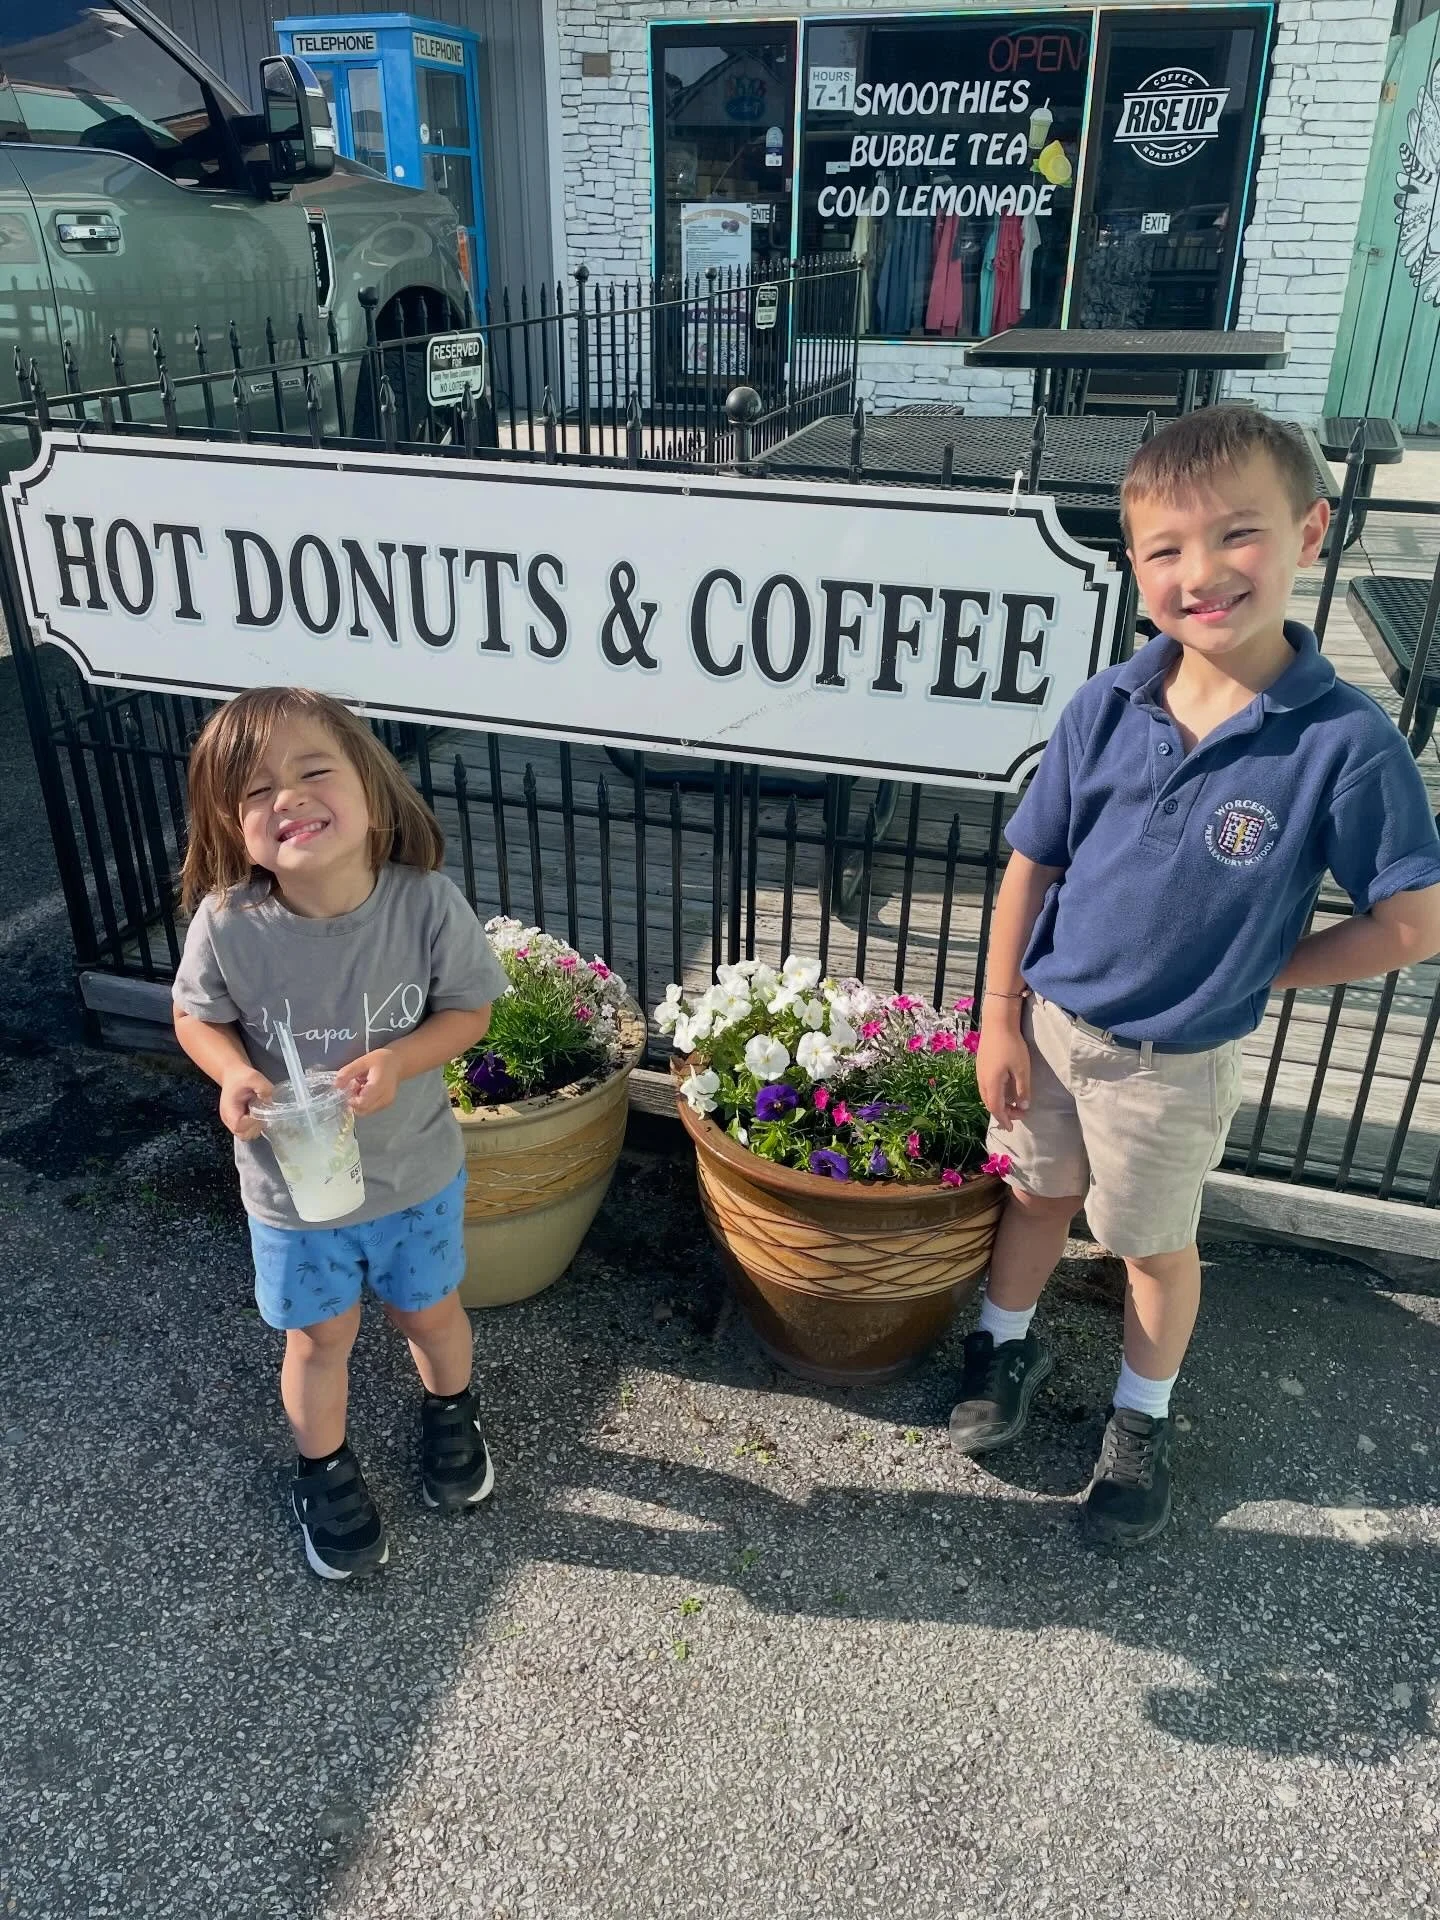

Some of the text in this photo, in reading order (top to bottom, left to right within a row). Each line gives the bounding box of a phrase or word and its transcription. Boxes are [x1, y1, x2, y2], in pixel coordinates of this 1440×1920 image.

[296, 34, 374, 52] TELEPHONE
[414, 37, 463, 63] TELEPHONE
[988, 34, 1083, 72] OPEN
[812, 71, 854, 82] HOURS:
[1153, 73, 1195, 86] COFFEE
[814, 84, 847, 107] 7-1
[853, 79, 1031, 115] SMOOTHIES
[1125, 97, 1219, 133] RISE UP
[850, 132, 1028, 167] BUBBLE TEA
[1142, 143, 1194, 160] ROASTERS
[817, 185, 890, 217] COLD
[896, 184, 1057, 217] LEMONADE
[752, 208, 774, 220] ENTE
[1144, 216, 1168, 230] EXIT
[433, 341, 480, 360] RESERVED
[452, 358, 463, 368] FOR
[440, 382, 448, 392] NO
[44, 513, 1055, 706] HOT DONUTS & COFFEE
[1214, 799, 1279, 831] WORCESTER
[1244, 840, 1274, 866] SCHOOL
[363, 982, 423, 1053] Kid
